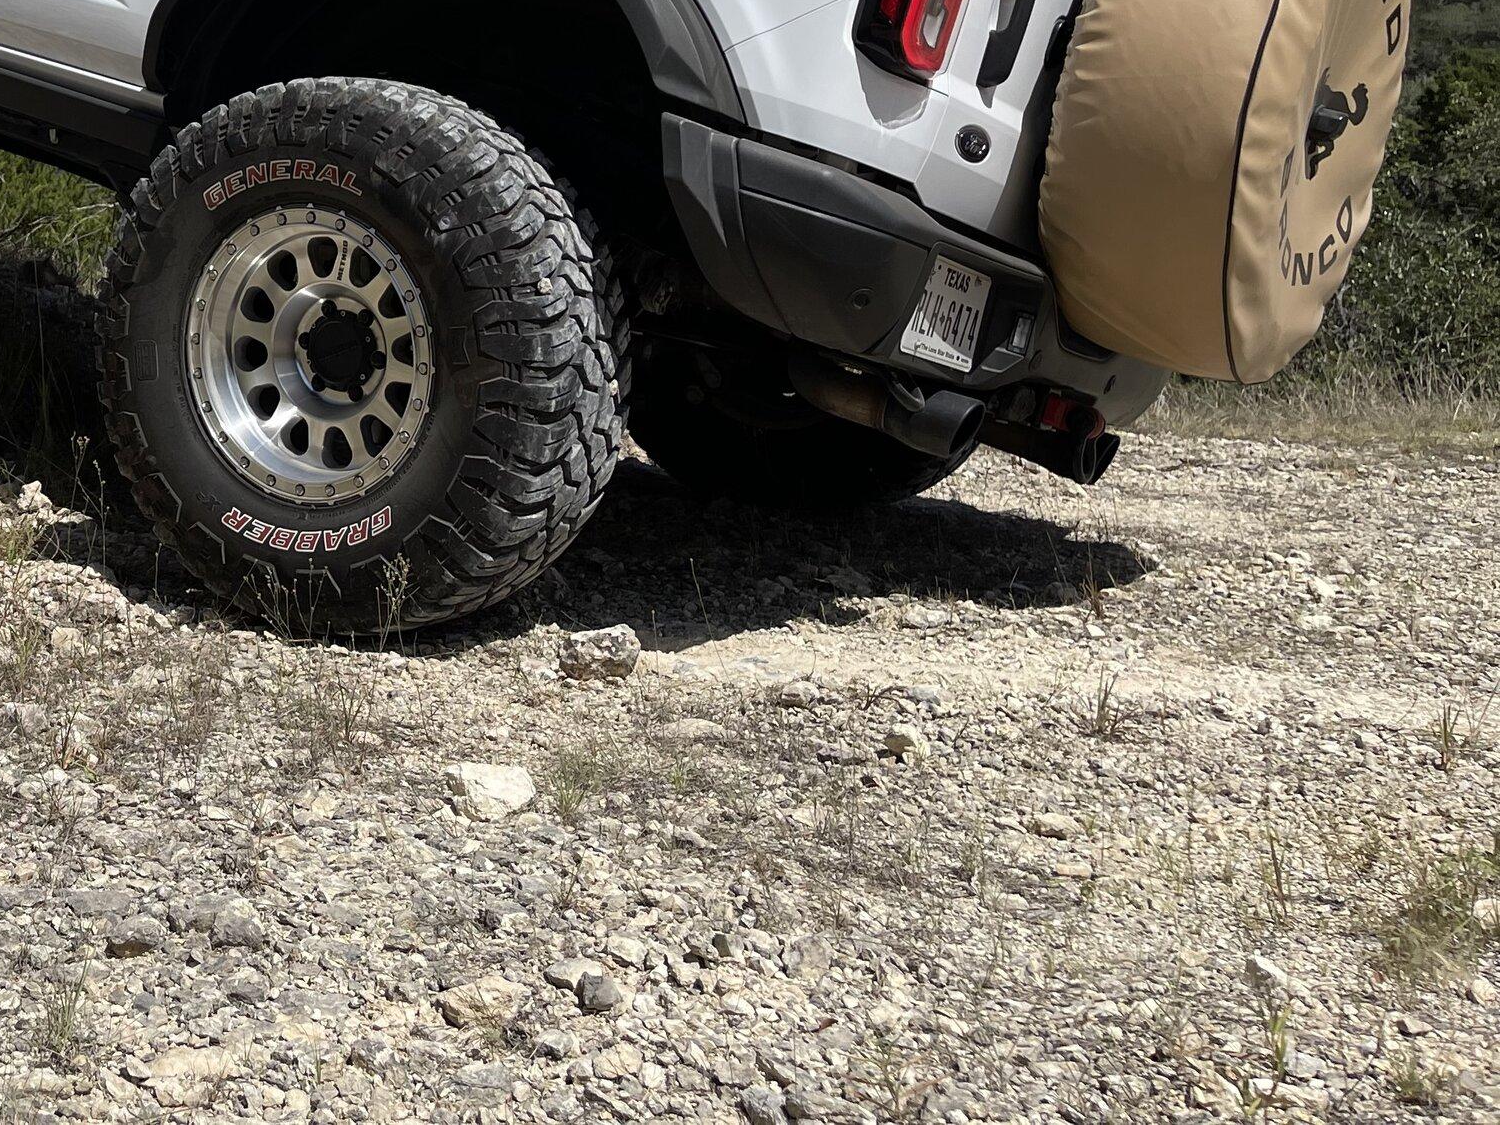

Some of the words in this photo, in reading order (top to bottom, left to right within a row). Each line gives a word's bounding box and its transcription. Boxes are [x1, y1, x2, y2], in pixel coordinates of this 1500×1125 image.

[203, 159, 363, 211] GENERAL
[336, 240, 349, 281] METHOD
[944, 268, 971, 293] TEXAS
[221, 505, 392, 552] GRABBER
